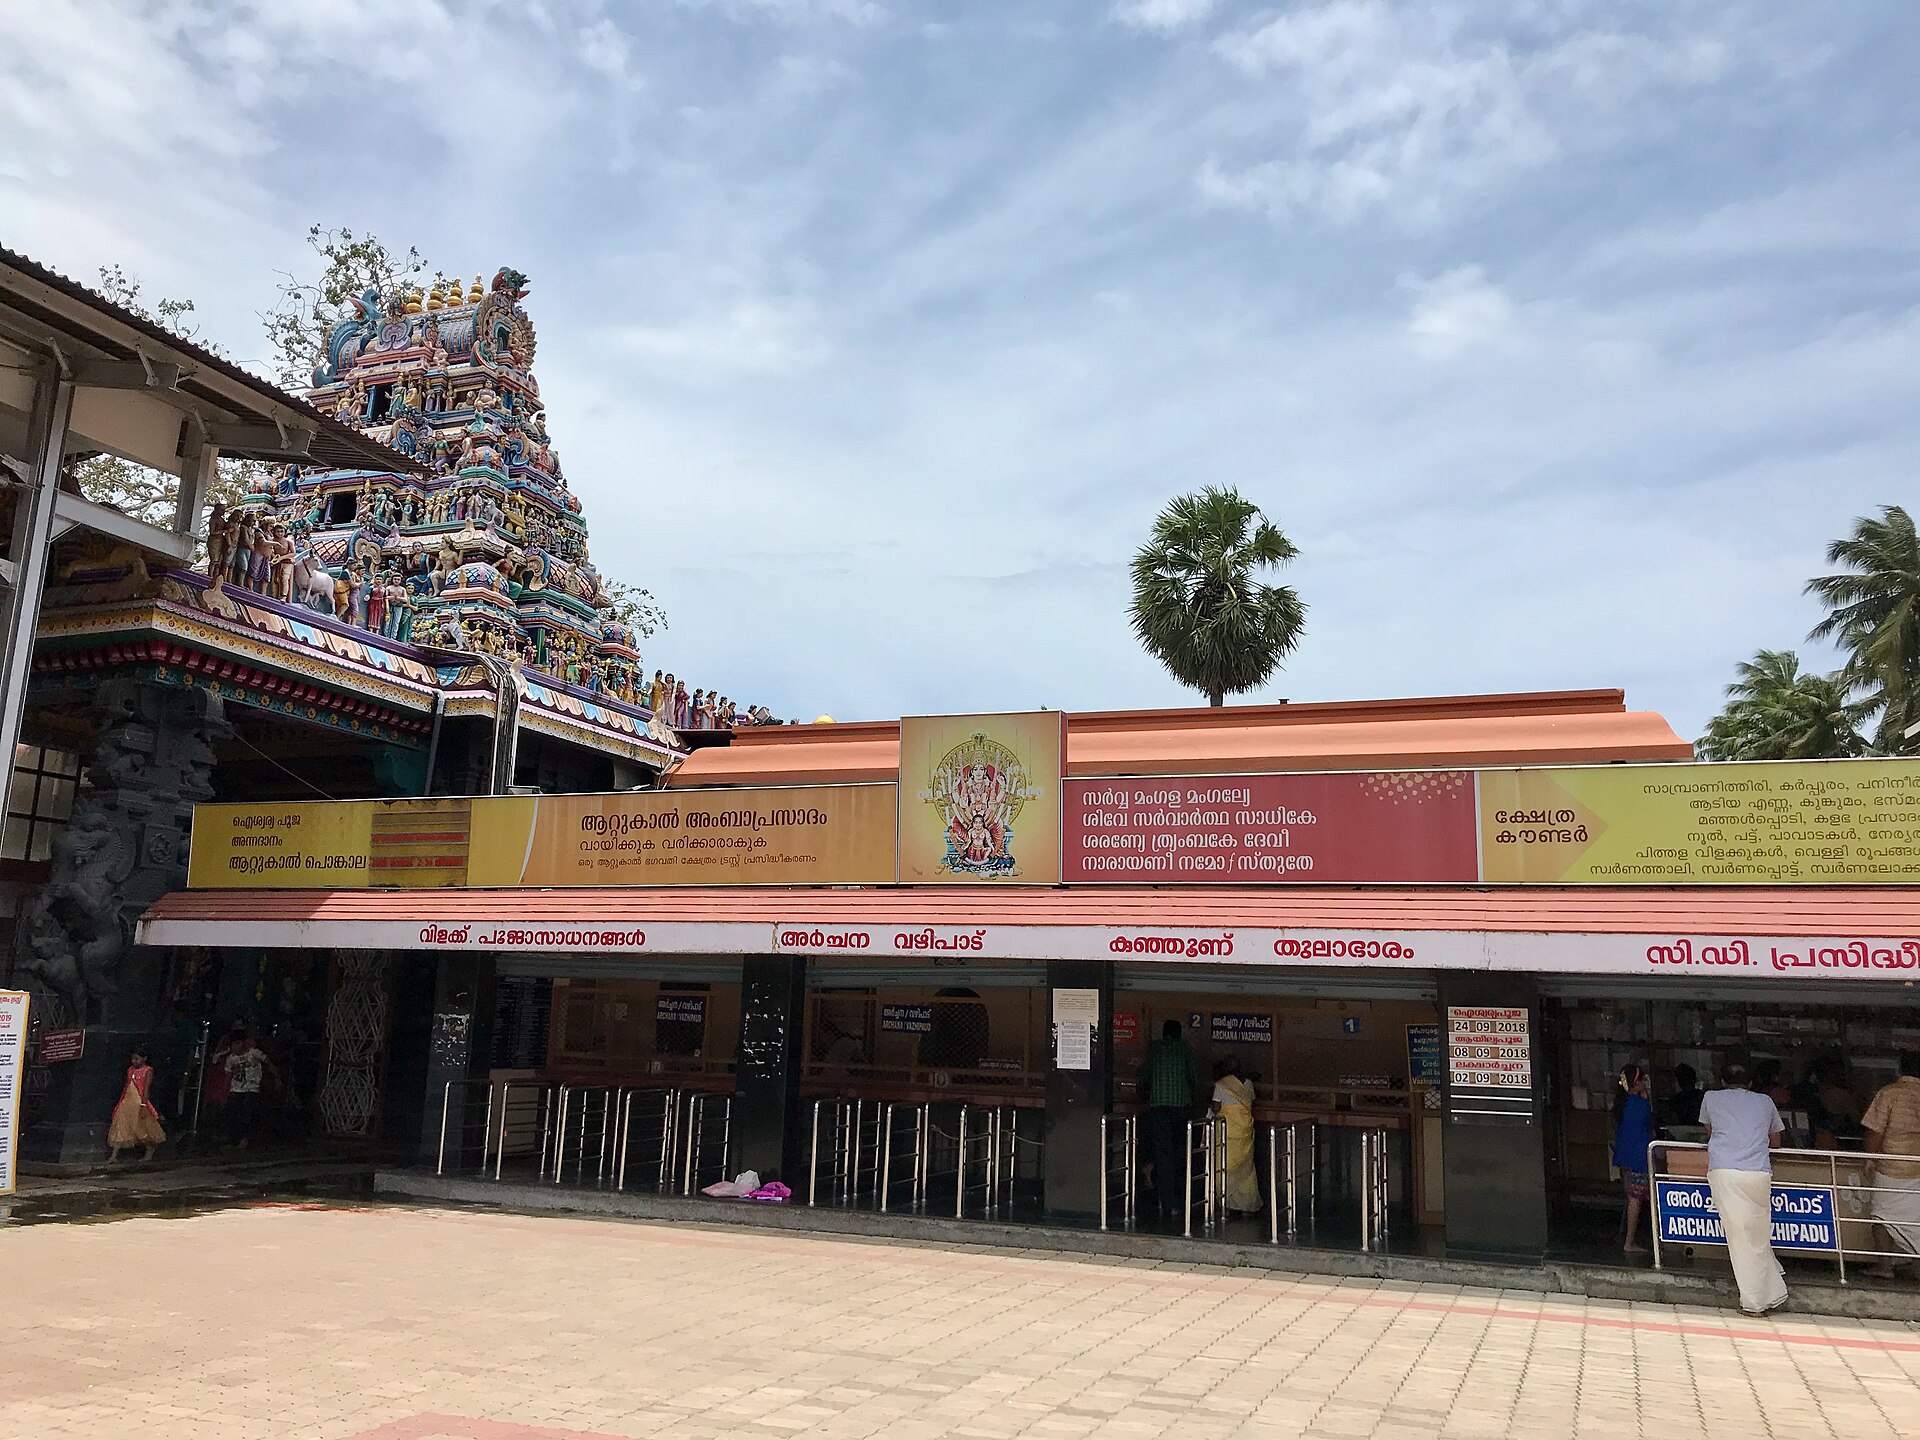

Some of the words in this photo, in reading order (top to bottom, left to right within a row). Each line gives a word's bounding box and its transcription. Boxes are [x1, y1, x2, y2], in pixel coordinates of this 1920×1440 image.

[1134, 790, 1182, 808] മംഗള
[1689, 796, 1741, 811] ആടിയ
[1799, 797, 1867, 811] കുങ്കുമം,
[232, 815, 275, 830] ഐശ്വര്യ
[277, 814, 301, 829] പൂജ
[581, 807, 680, 837] ആറ്റുകാൽ
[685, 807, 829, 832] അംബാപ്രസാദം
[1082, 808, 1129, 827] ശിവേ
[1234, 805, 1318, 825] സാധികേ
[1495, 809, 1576, 826] ക്ഷേത്ര
[1813, 813, 1852, 826] കളഭ
[231, 835, 283, 847] അന്നദാനം
[1082, 832, 1146, 853] ശരണ്യേ
[1244, 828, 1290, 848] ദേവീ
[1495, 824, 1589, 843] കൗണ്ടർ
[1734, 827, 1762, 844] പട്ട്,
[1769, 827, 1861, 842] പാവാടകൾ,
[579, 837, 656, 855] വായിക്കുക
[661, 835, 768, 852] വരിക്കാരാകുക
[1635, 846, 1689, 861] പിത്തള
[1694, 845, 1788, 861] വിളക്കുകൾ,
[1794, 844, 1849, 860] വെള്ളി
[228, 851, 302, 875] ആറ്റുകാൽ
[305, 854, 367, 869] പൊങ്കാല
[577, 858, 594, 869] ഒരു
[596, 856, 642, 870] ആറ്റുകാൽ
[644, 855, 678, 866] ഭഗവതി
[680, 856, 717, 866] ക്ഷേത്രം
[1082, 852, 1174, 870] നാരായണീ
[478, 928, 647, 947] പൂജാസാധനങ്ങൾ
[780, 928, 871, 949] അർച്ചന
[894, 927, 987, 951] വഴിപാട്
[1108, 932, 1235, 958] കുഞ്ഞൂണ്
[1273, 938, 1415, 960] തുലാഭാരം
[1646, 938, 1759, 966] സി.ഡി.
[1192, 1014, 1201, 1028] 2
[1212, 1015, 1239, 1029] അർച്ചന
[1244, 1016, 1271, 1028] വഴിപാട്
[1345, 1018, 1355, 1032] 1
[1455, 1021, 1469, 1031] 24
[1476, 1022, 1490, 1032] 09
[1498, 1022, 1526, 1032] 2018
[1212, 1030, 1238, 1041] ARCHANA
[1454, 1047, 1469, 1057] 08
[1476, 1048, 1490, 1057] 09
[1499, 1048, 1528, 1058] 2018
[1455, 1073, 1469, 1083] 02
[1476, 1073, 1490, 1083] 09
[1499, 1074, 1528, 1084] 2018
